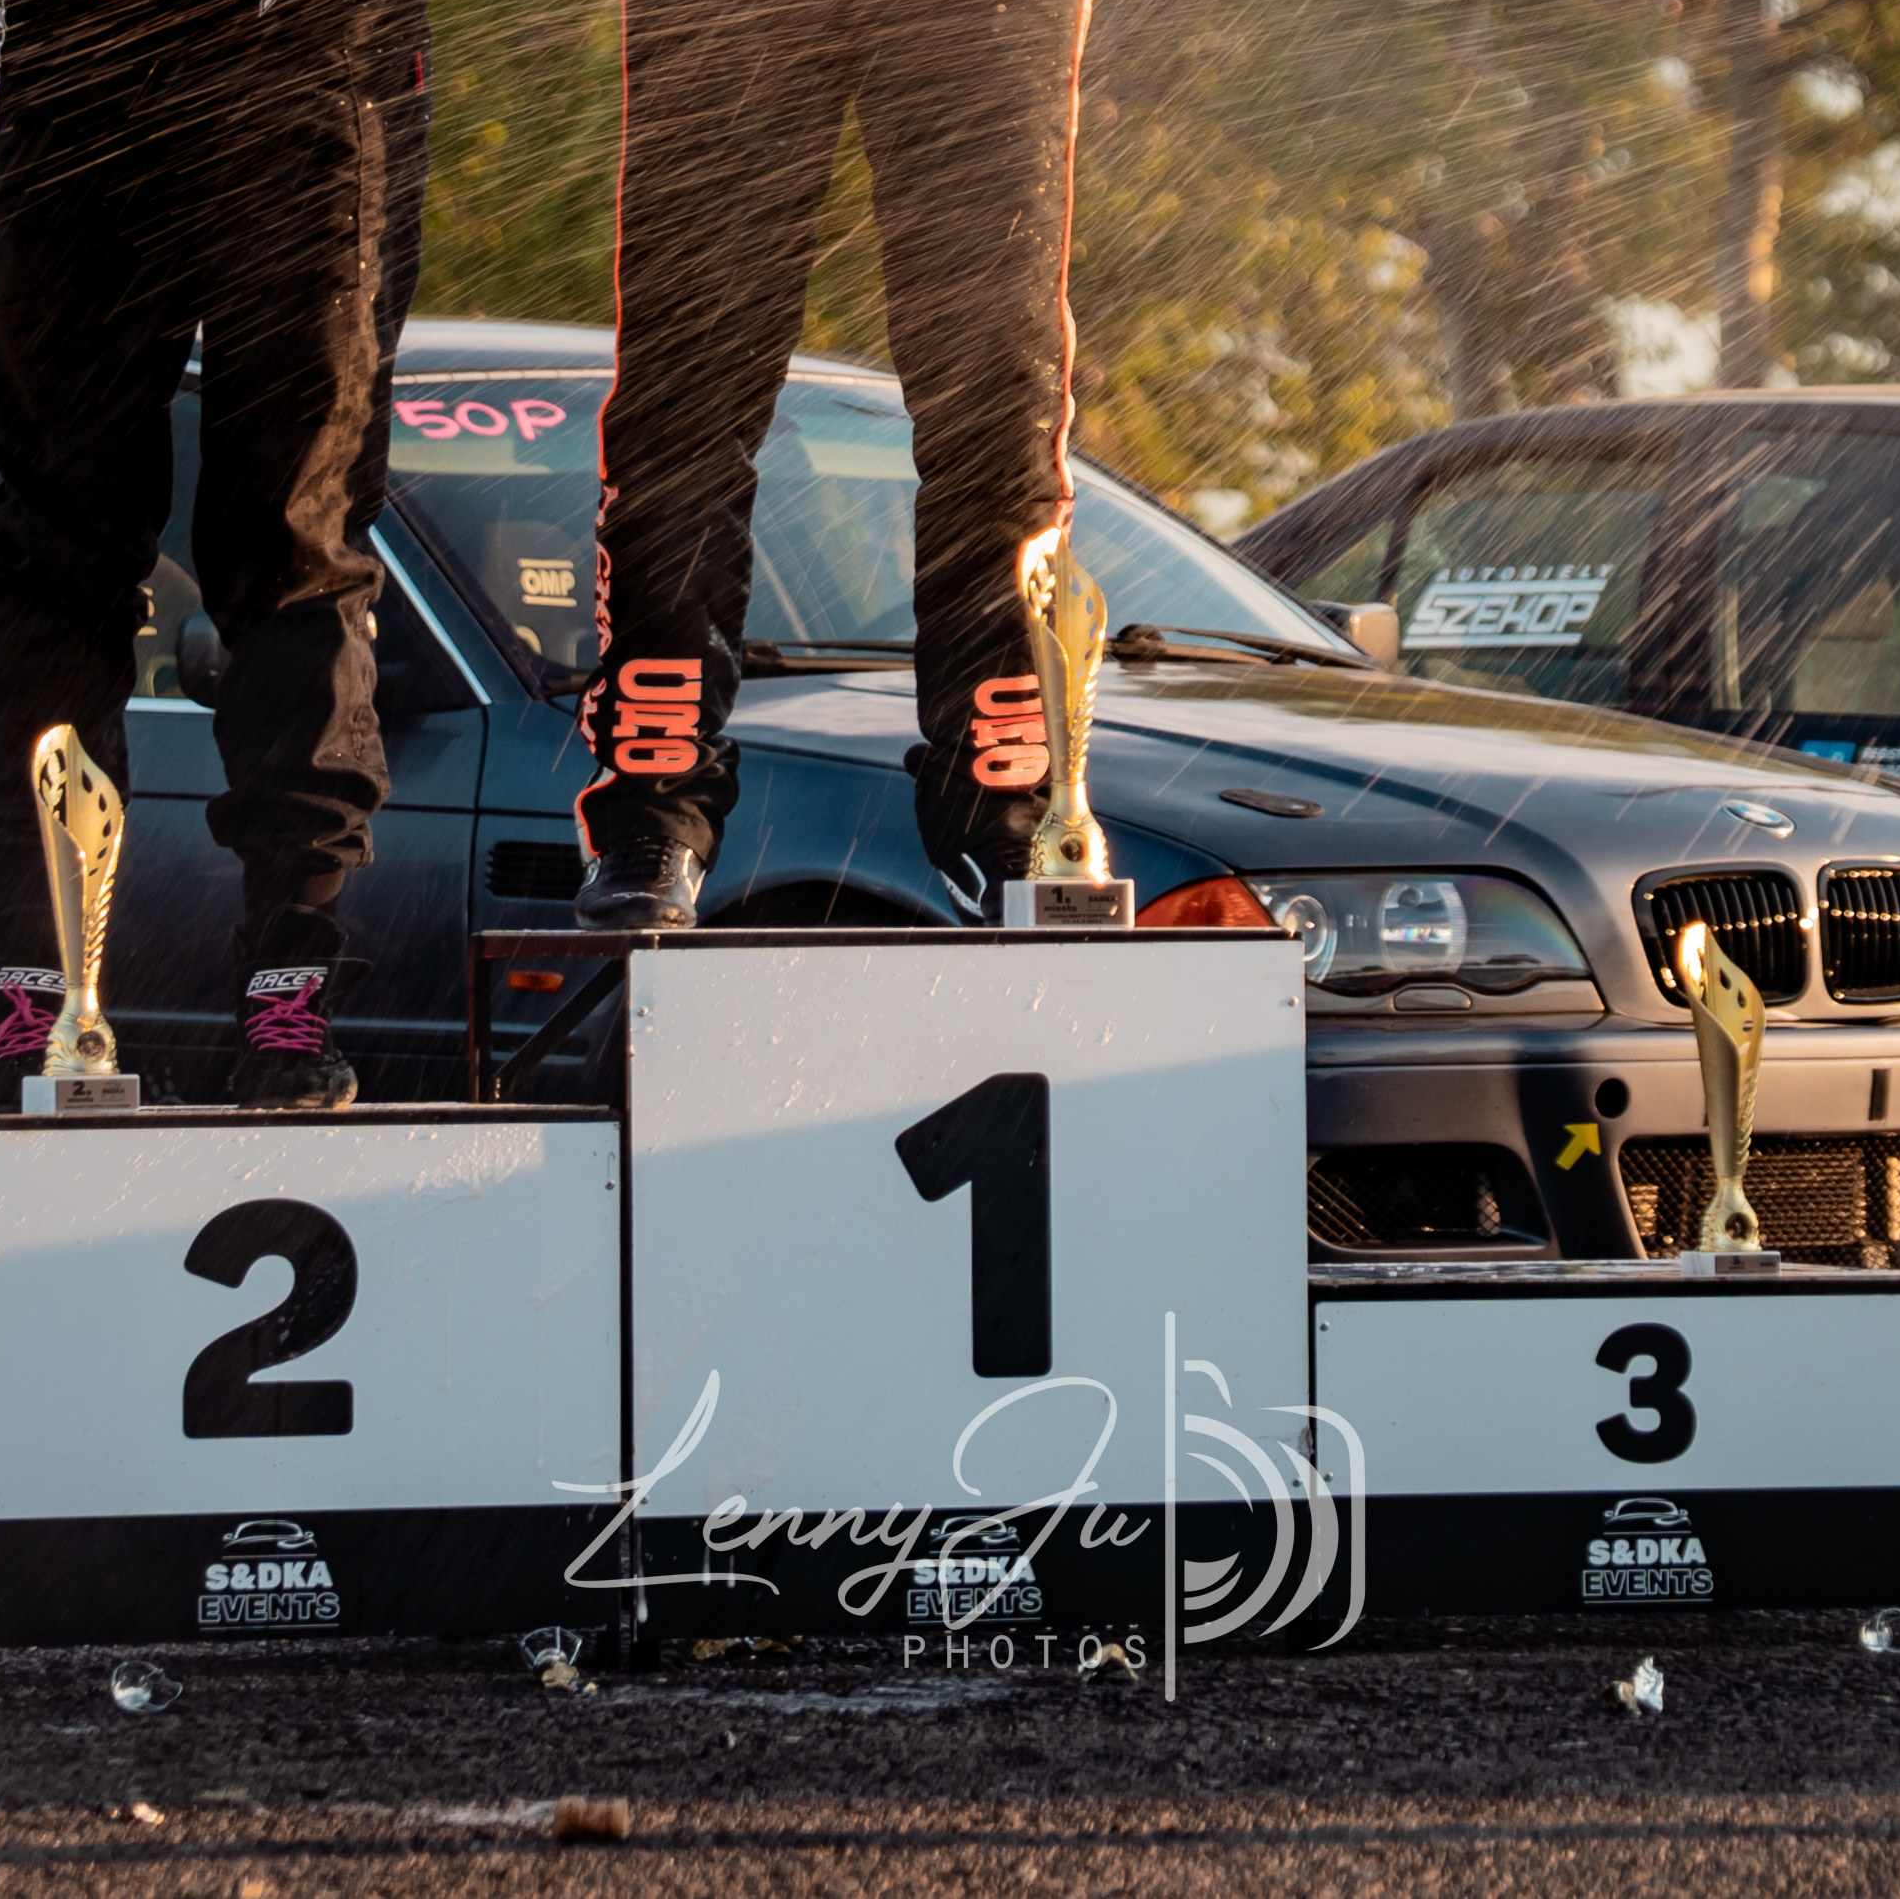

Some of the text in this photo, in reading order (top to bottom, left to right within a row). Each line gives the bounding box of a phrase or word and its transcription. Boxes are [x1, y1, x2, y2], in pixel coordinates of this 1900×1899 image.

[520, 567, 576, 597] OMP
[1434, 563, 1614, 584] AUTODIELY
[894, 1072, 1054, 1378] 1
[182, 1196, 359, 1440] 2
[1594, 1322, 1698, 1464] 3
[1587, 1537, 1708, 1567] S&DKA
[204, 1561, 334, 1590] S&DKA
[913, 1556, 1037, 1586] S&DKA
[1582, 1568, 1714, 1599] EVENTS
[197, 1591, 341, 1624] EVENTS
[907, 1587, 1044, 1618] EVENTS
